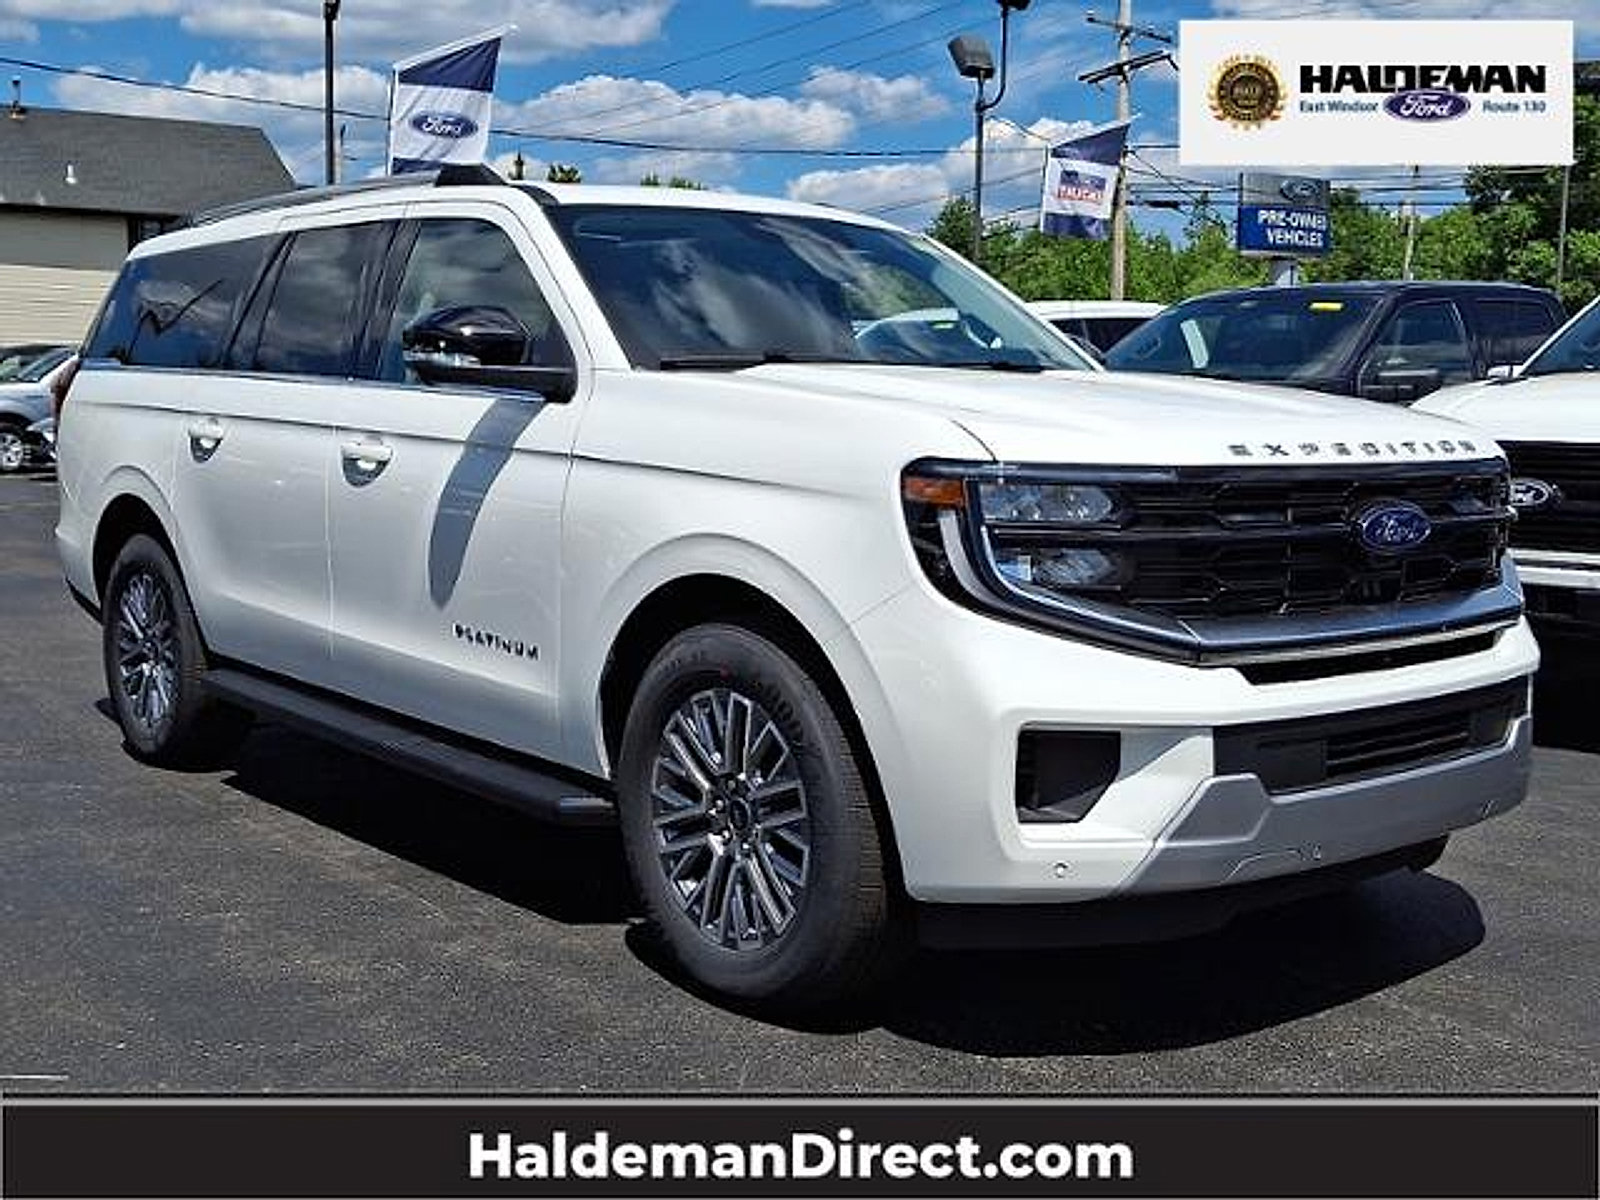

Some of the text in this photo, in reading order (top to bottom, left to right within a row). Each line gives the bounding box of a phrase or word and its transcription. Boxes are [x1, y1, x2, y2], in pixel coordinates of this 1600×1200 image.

[422, 116, 464, 136] Ford
[1266, 227, 1324, 248] VEHICLES
[1228, 439, 1477, 457] EXPEDITION
[453, 623, 540, 661] PLATINUM
